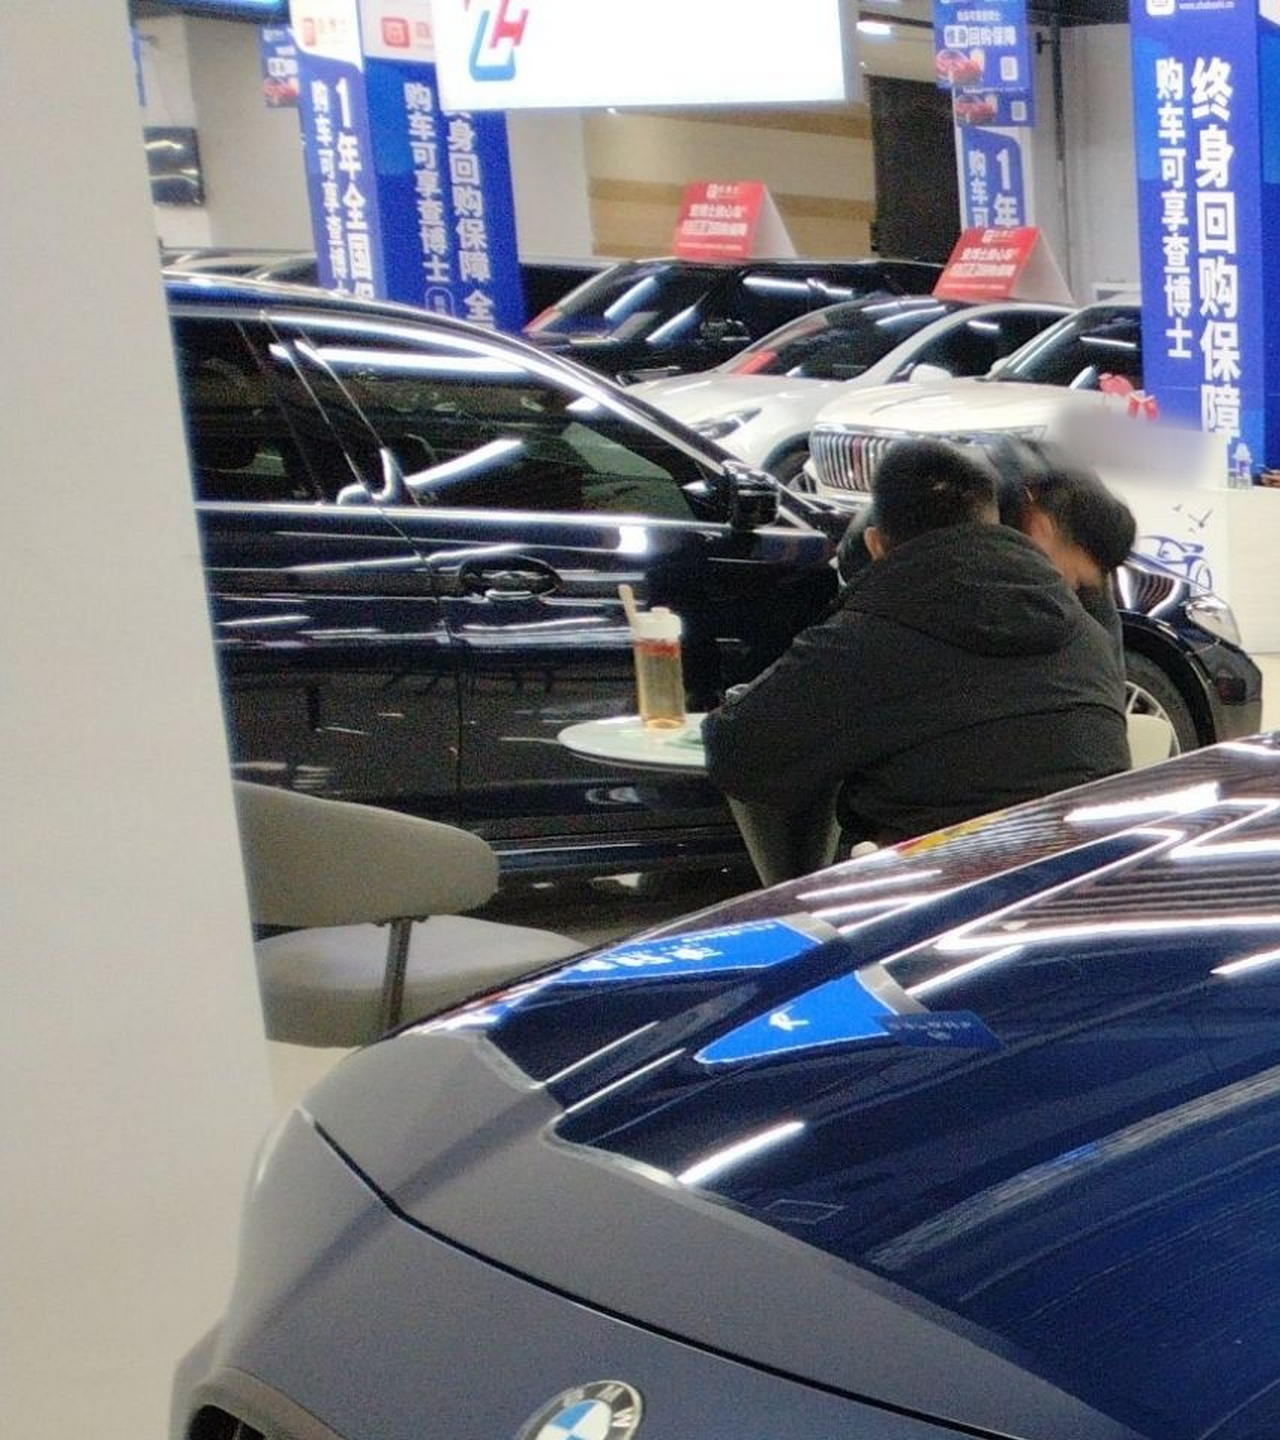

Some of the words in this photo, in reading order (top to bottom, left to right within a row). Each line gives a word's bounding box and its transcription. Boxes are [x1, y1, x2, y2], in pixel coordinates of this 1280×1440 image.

[404, 82, 450, 283] 购车可享查博士
[449, 112, 491, 283] 身回购保障
[996, 149, 1020, 228] 1年
[1155, 57, 1193, 359] 购车可享查博士
[1191, 57, 1241, 437] 终身回购保障
